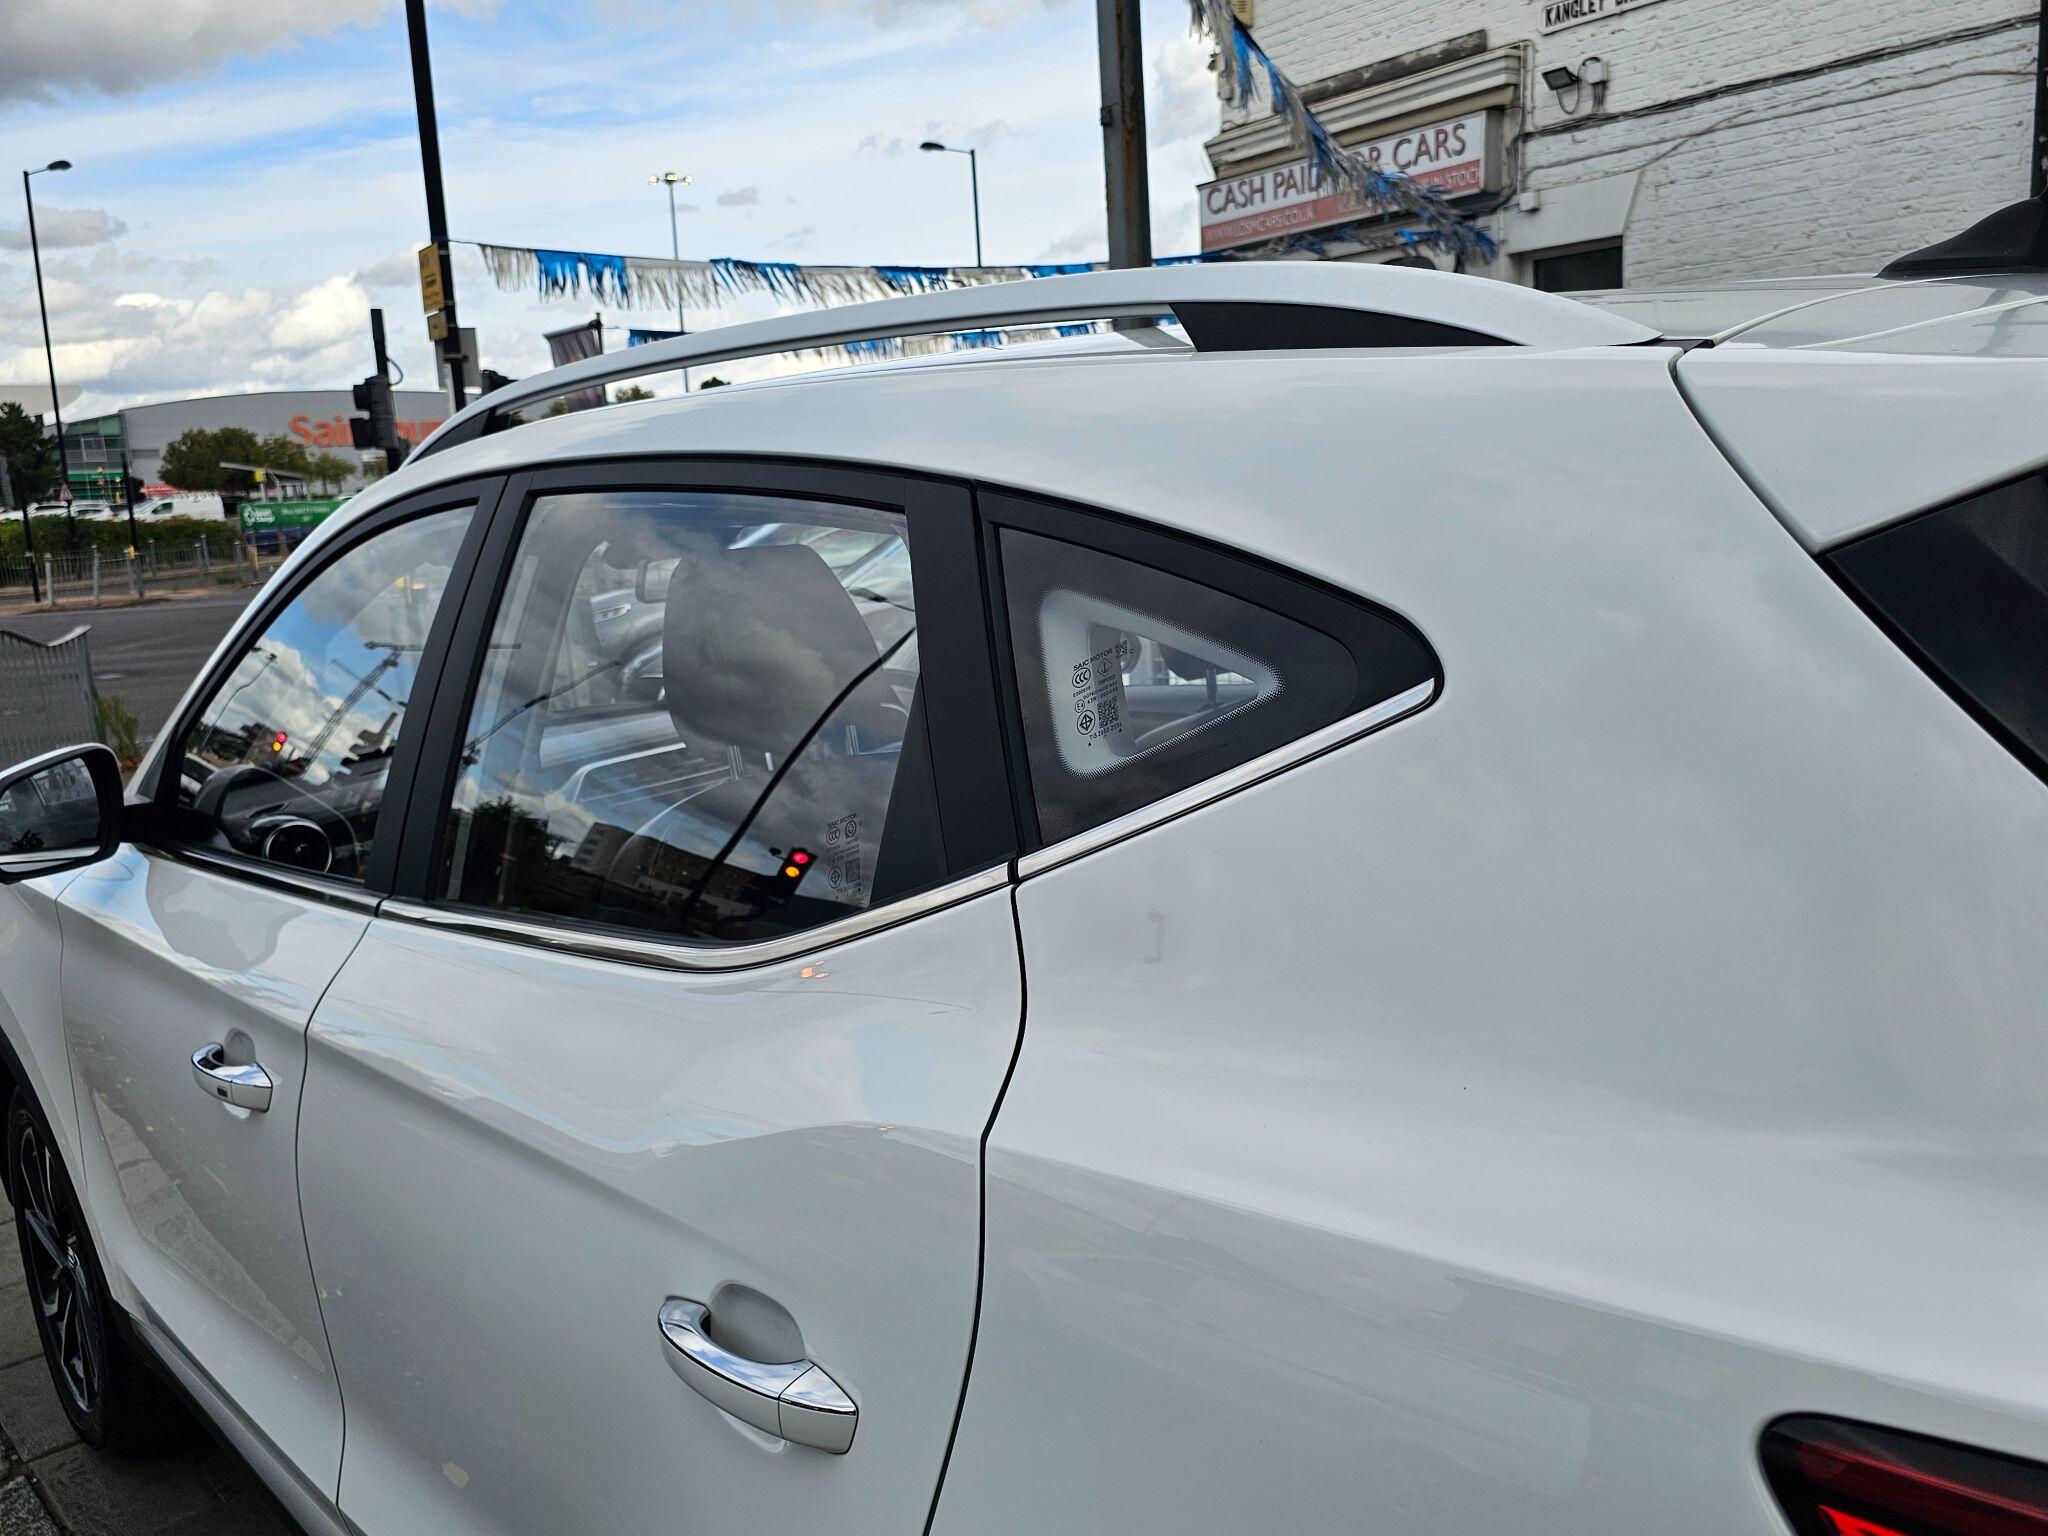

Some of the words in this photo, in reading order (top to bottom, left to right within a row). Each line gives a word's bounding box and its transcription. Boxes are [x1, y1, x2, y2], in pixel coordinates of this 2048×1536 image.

[1207, 176, 1265, 215] CASH
[1393, 122, 1467, 171] CARS
[1073, 659, 1090, 671] SAIC
[1090, 648, 1113, 664] MOTOR
